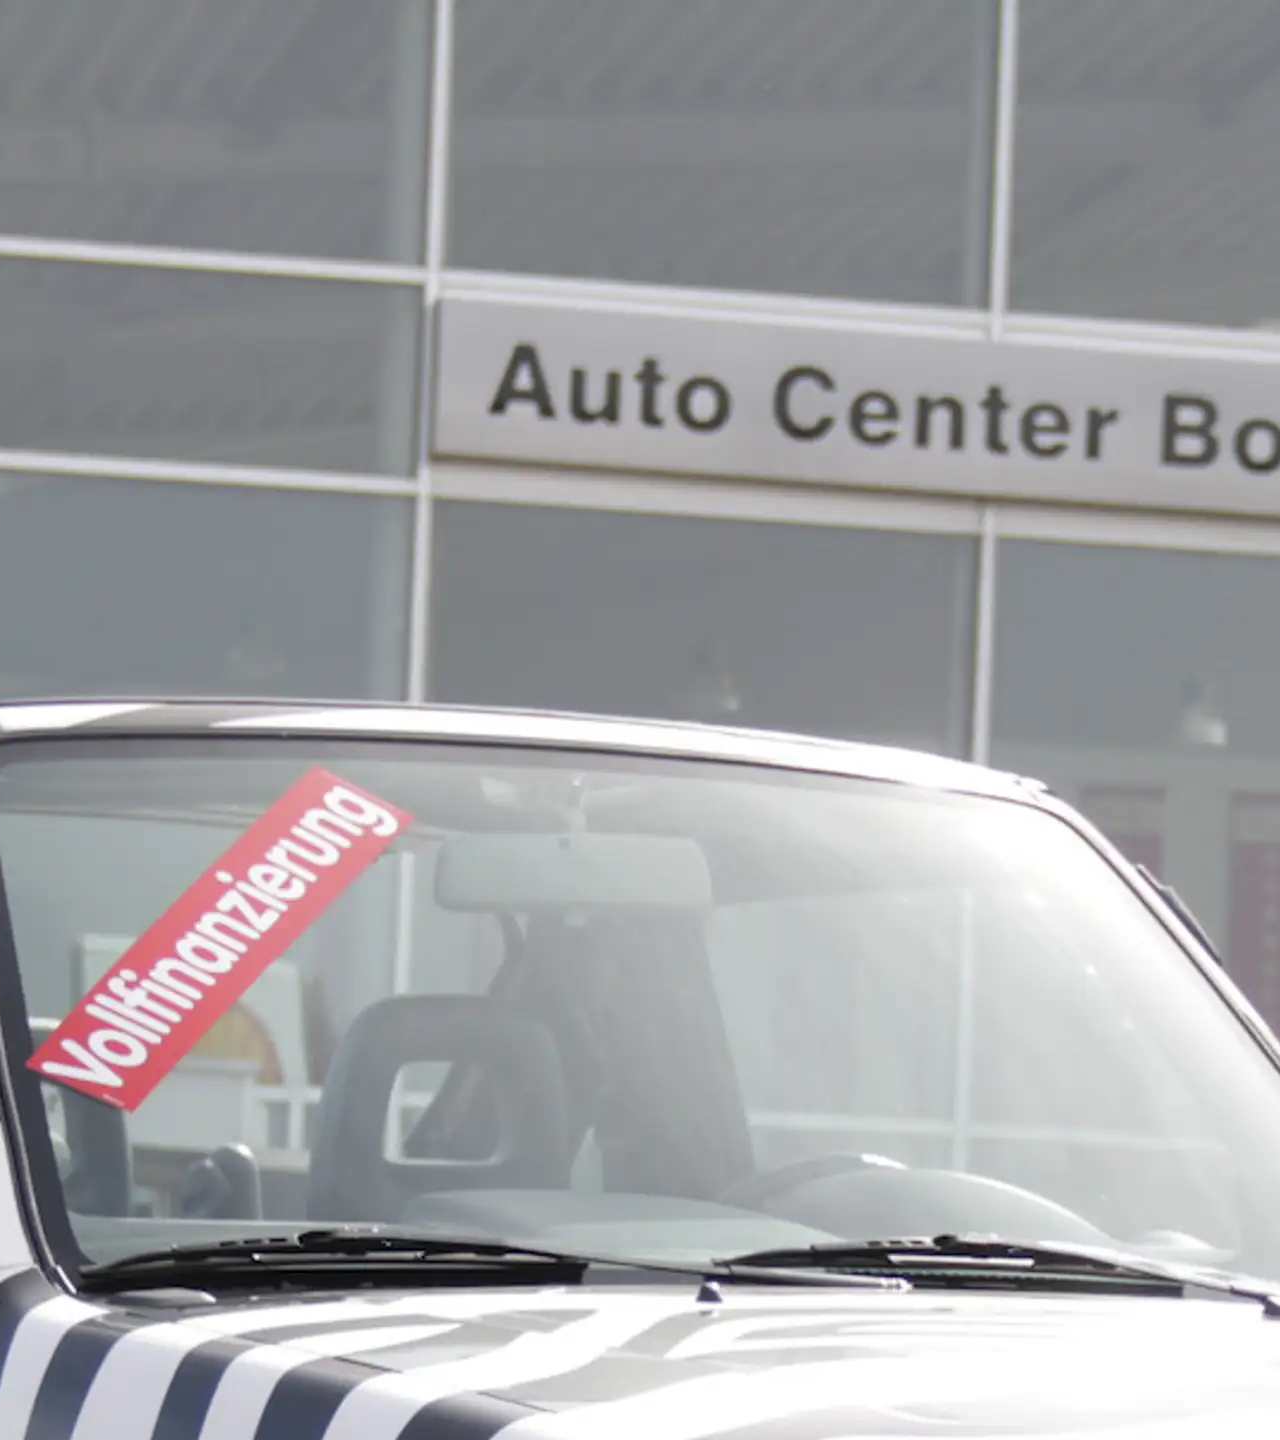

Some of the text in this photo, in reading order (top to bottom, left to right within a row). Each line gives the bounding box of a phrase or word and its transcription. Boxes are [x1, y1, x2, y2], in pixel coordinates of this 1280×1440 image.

[488, 341, 732, 434] Auto
[773, 364, 1119, 461] Center
[40, 784, 399, 1089] Vollfinanzierung
